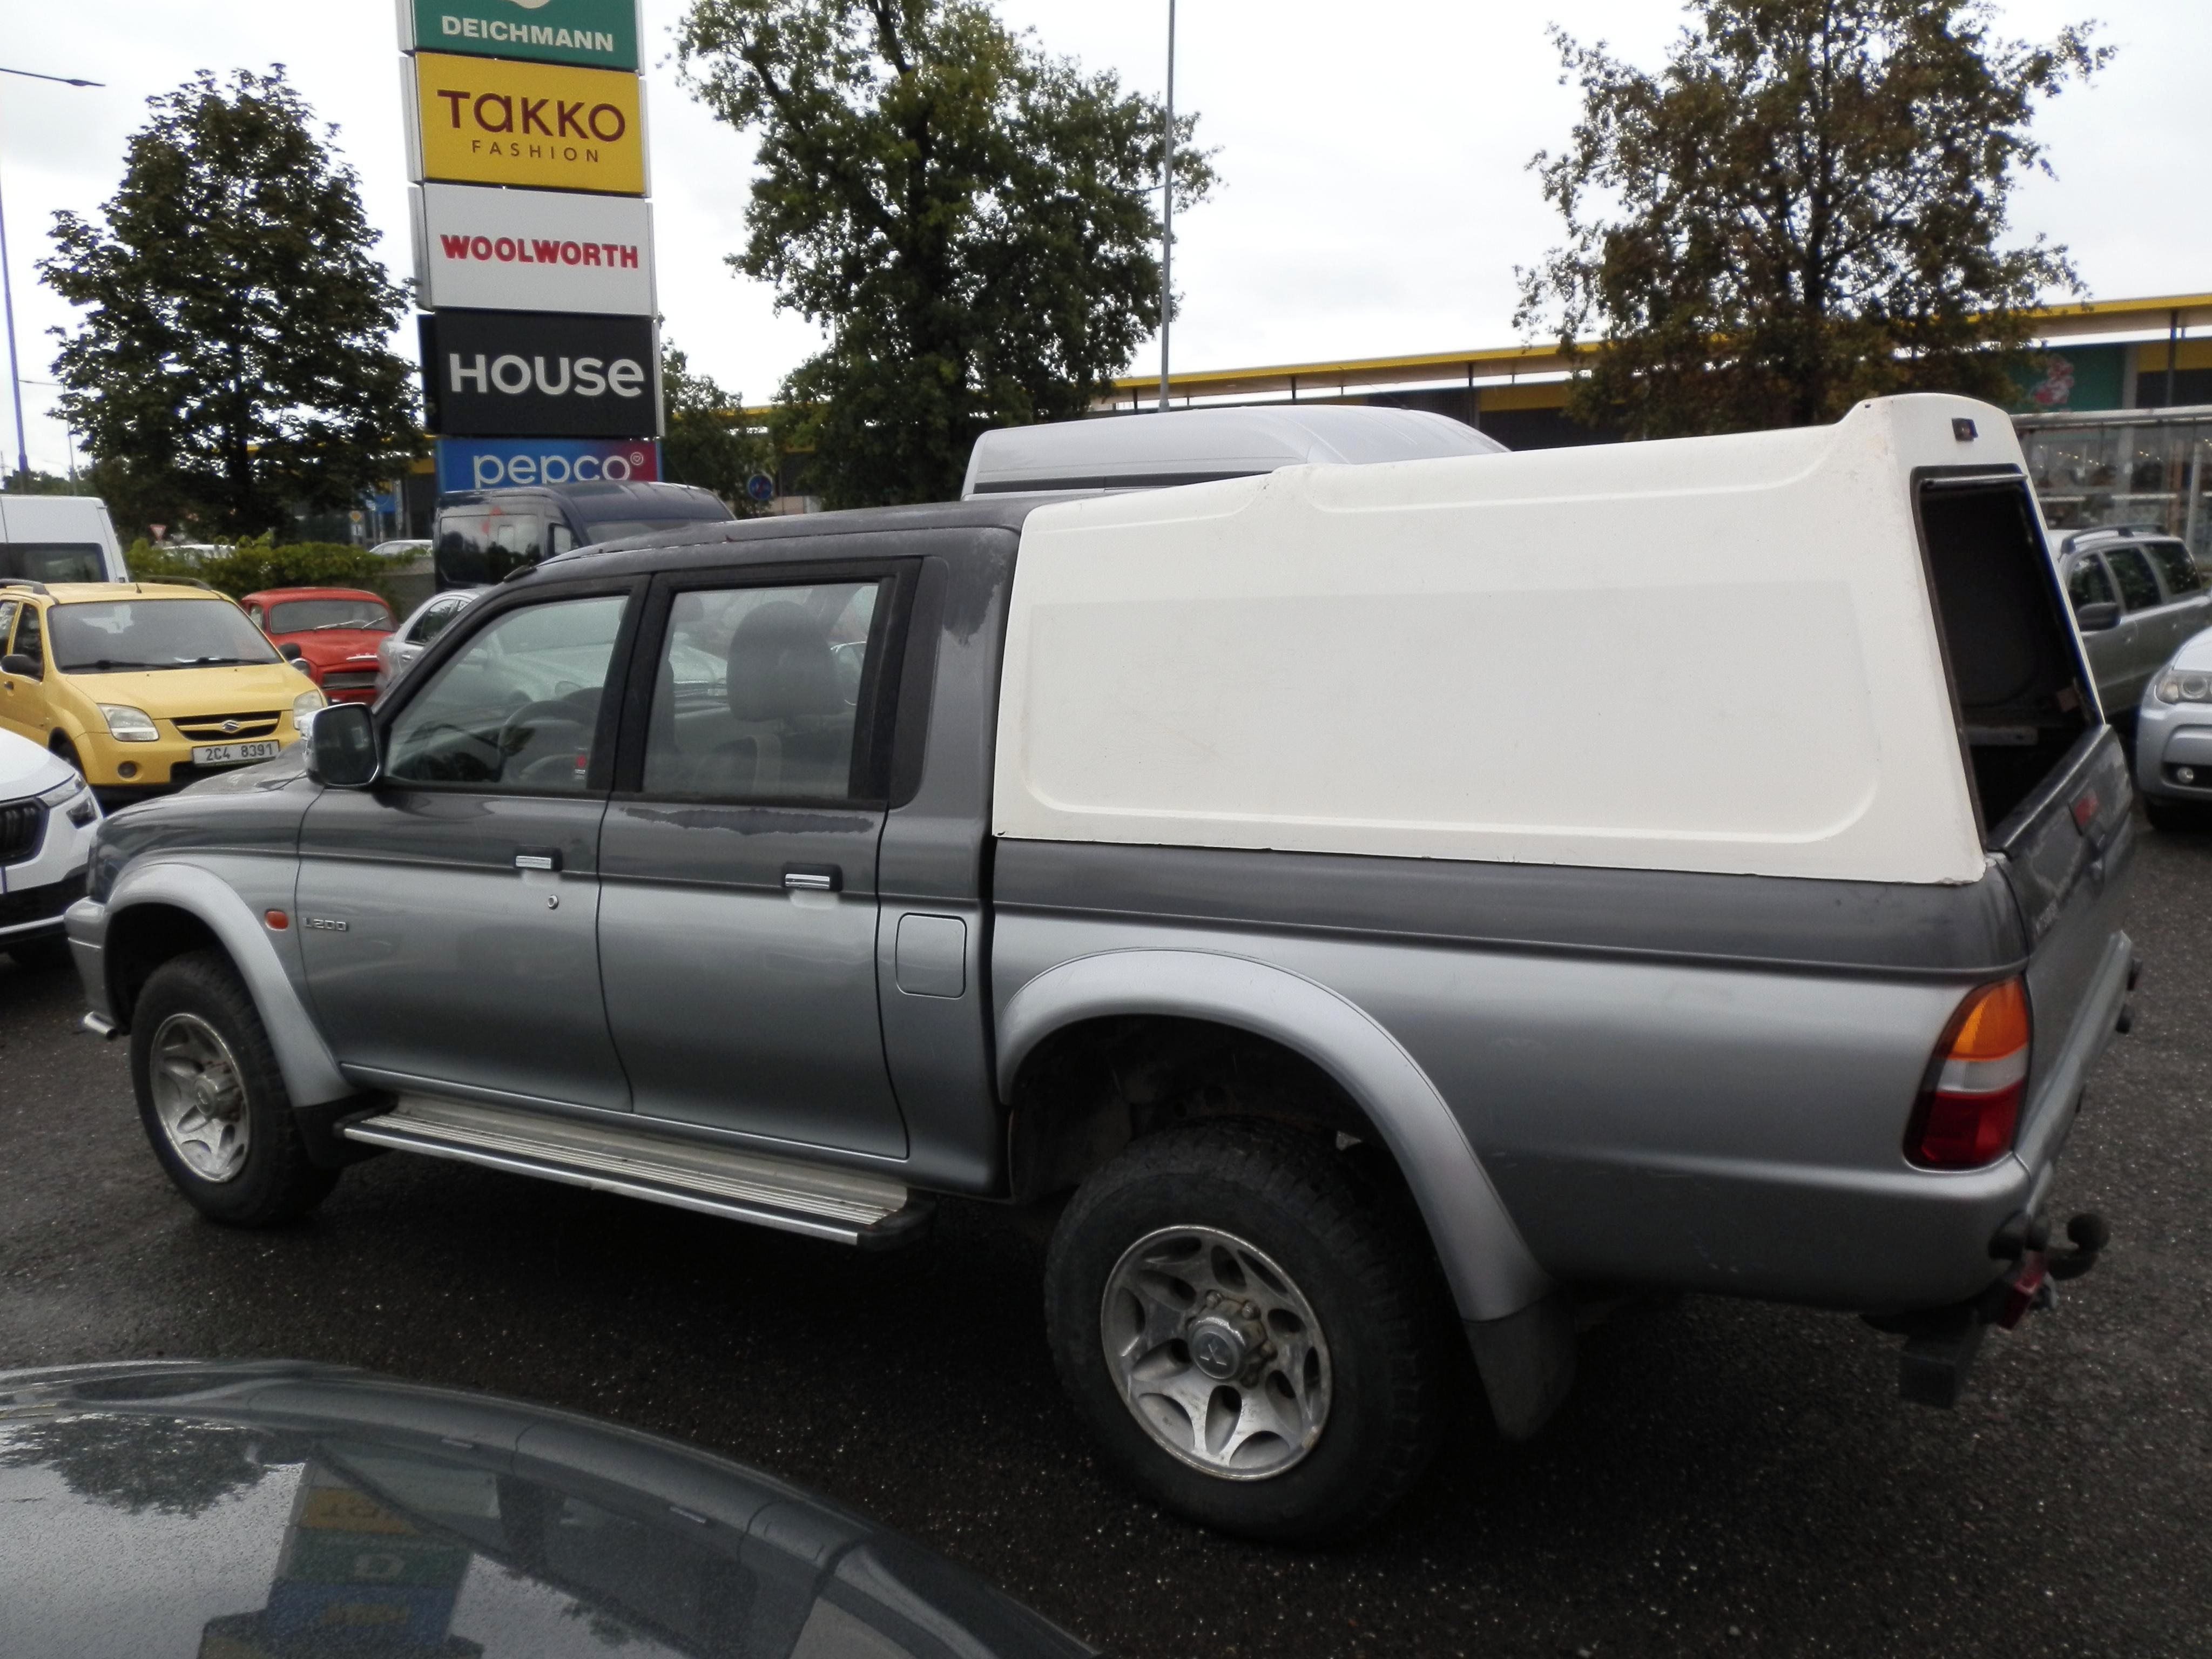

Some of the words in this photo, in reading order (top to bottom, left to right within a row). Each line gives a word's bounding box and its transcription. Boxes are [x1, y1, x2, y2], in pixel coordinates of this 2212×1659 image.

[441, 15, 614, 52] DEICHMANN
[471, 139, 599, 163] FASHION
[440, 234, 639, 269] WOOLWORTH
[473, 454, 631, 489] pepco
[205, 747, 231, 761] 2C4
[241, 743, 272, 757] 8391
[302, 918, 347, 931] L200
